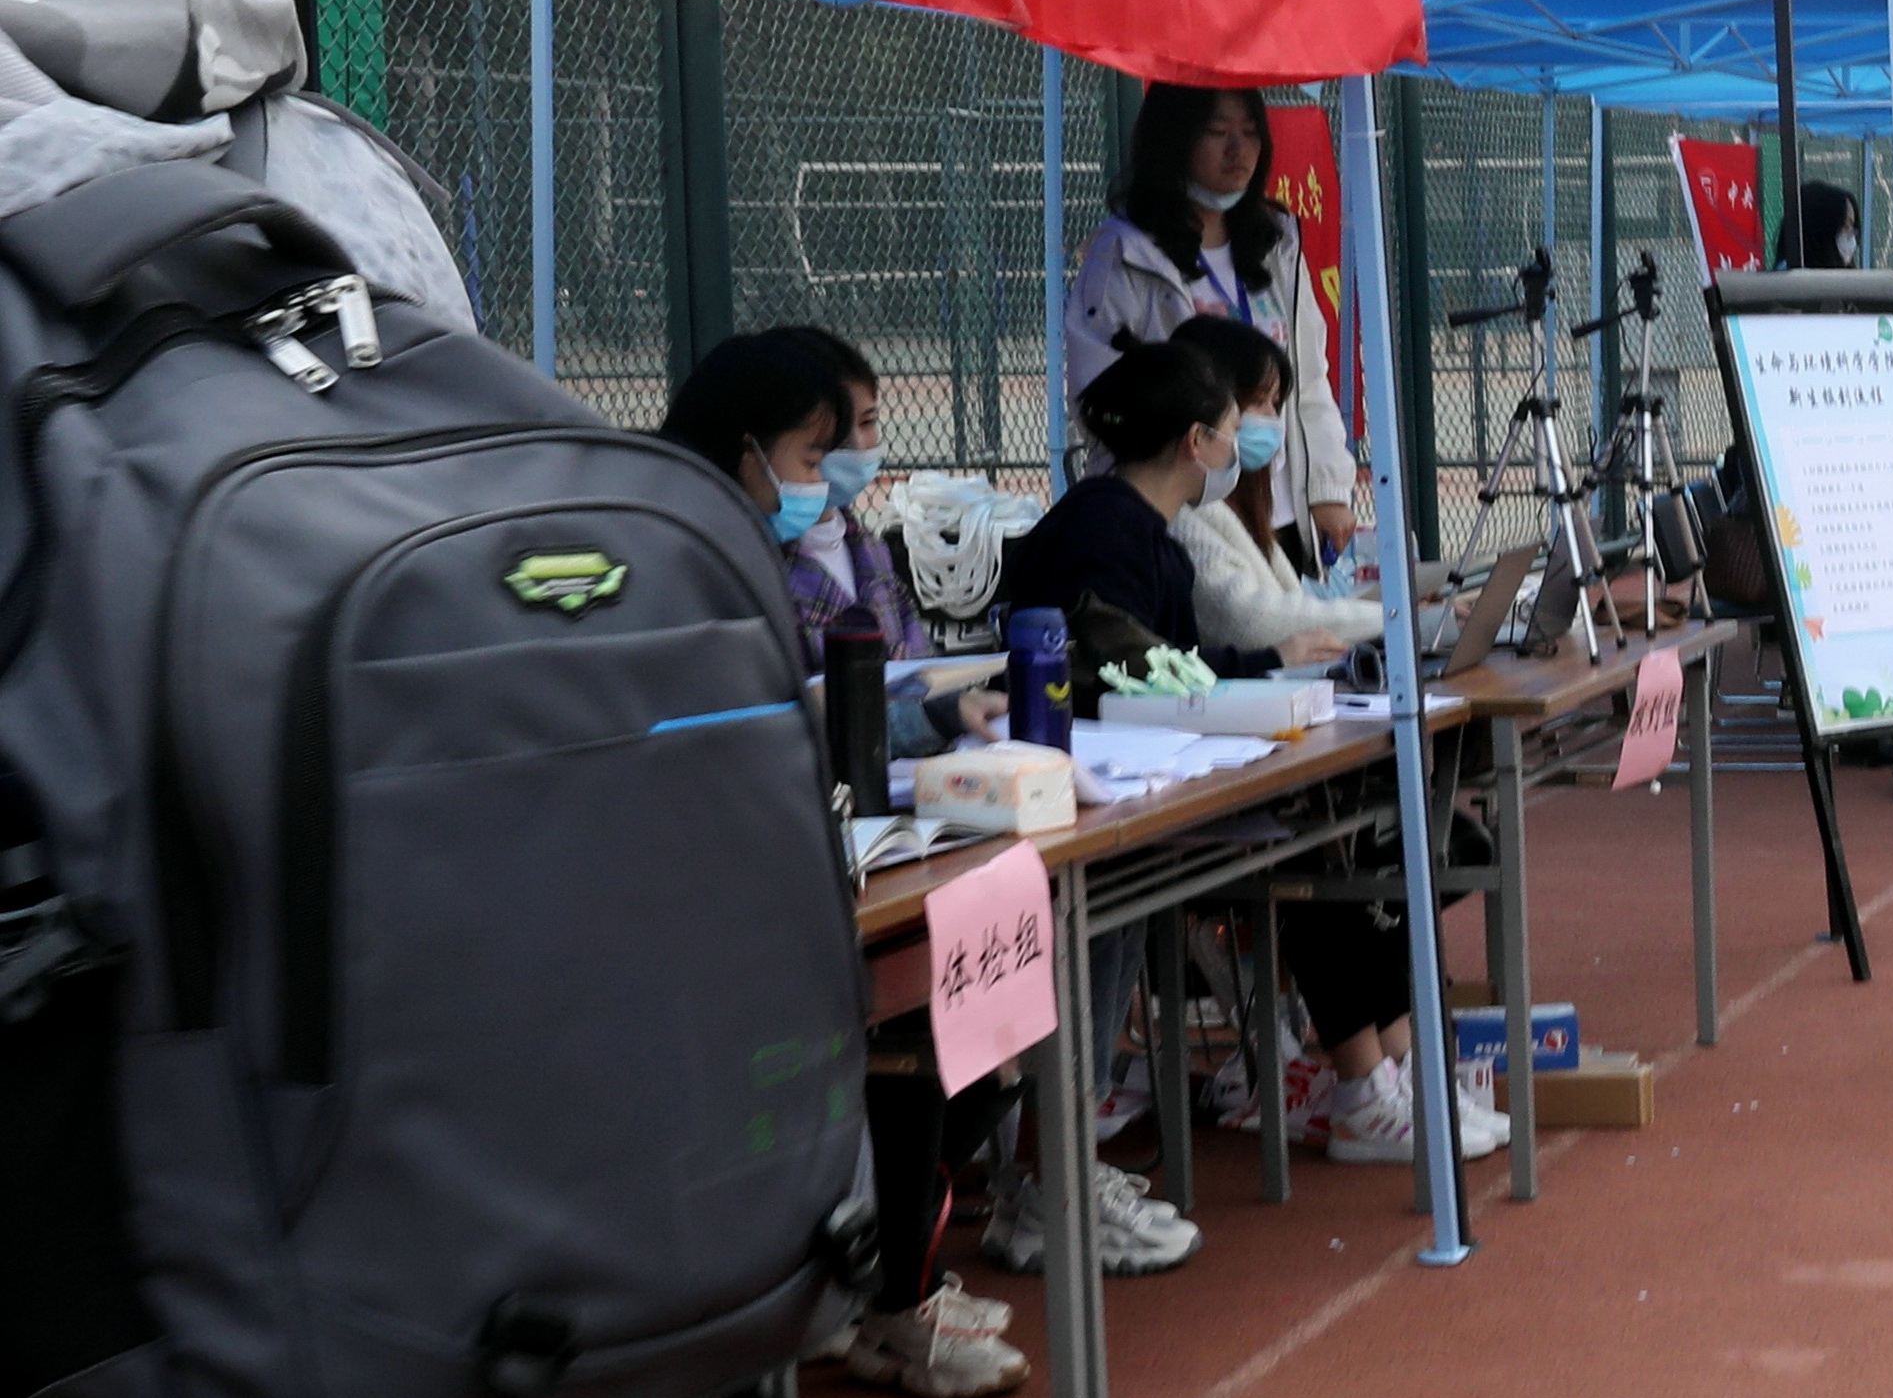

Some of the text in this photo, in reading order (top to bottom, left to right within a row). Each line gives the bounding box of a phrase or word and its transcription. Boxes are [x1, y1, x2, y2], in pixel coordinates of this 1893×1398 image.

[1264, 164, 1324, 225] 族大学
[937, 908, 1043, 1012] 体检组
